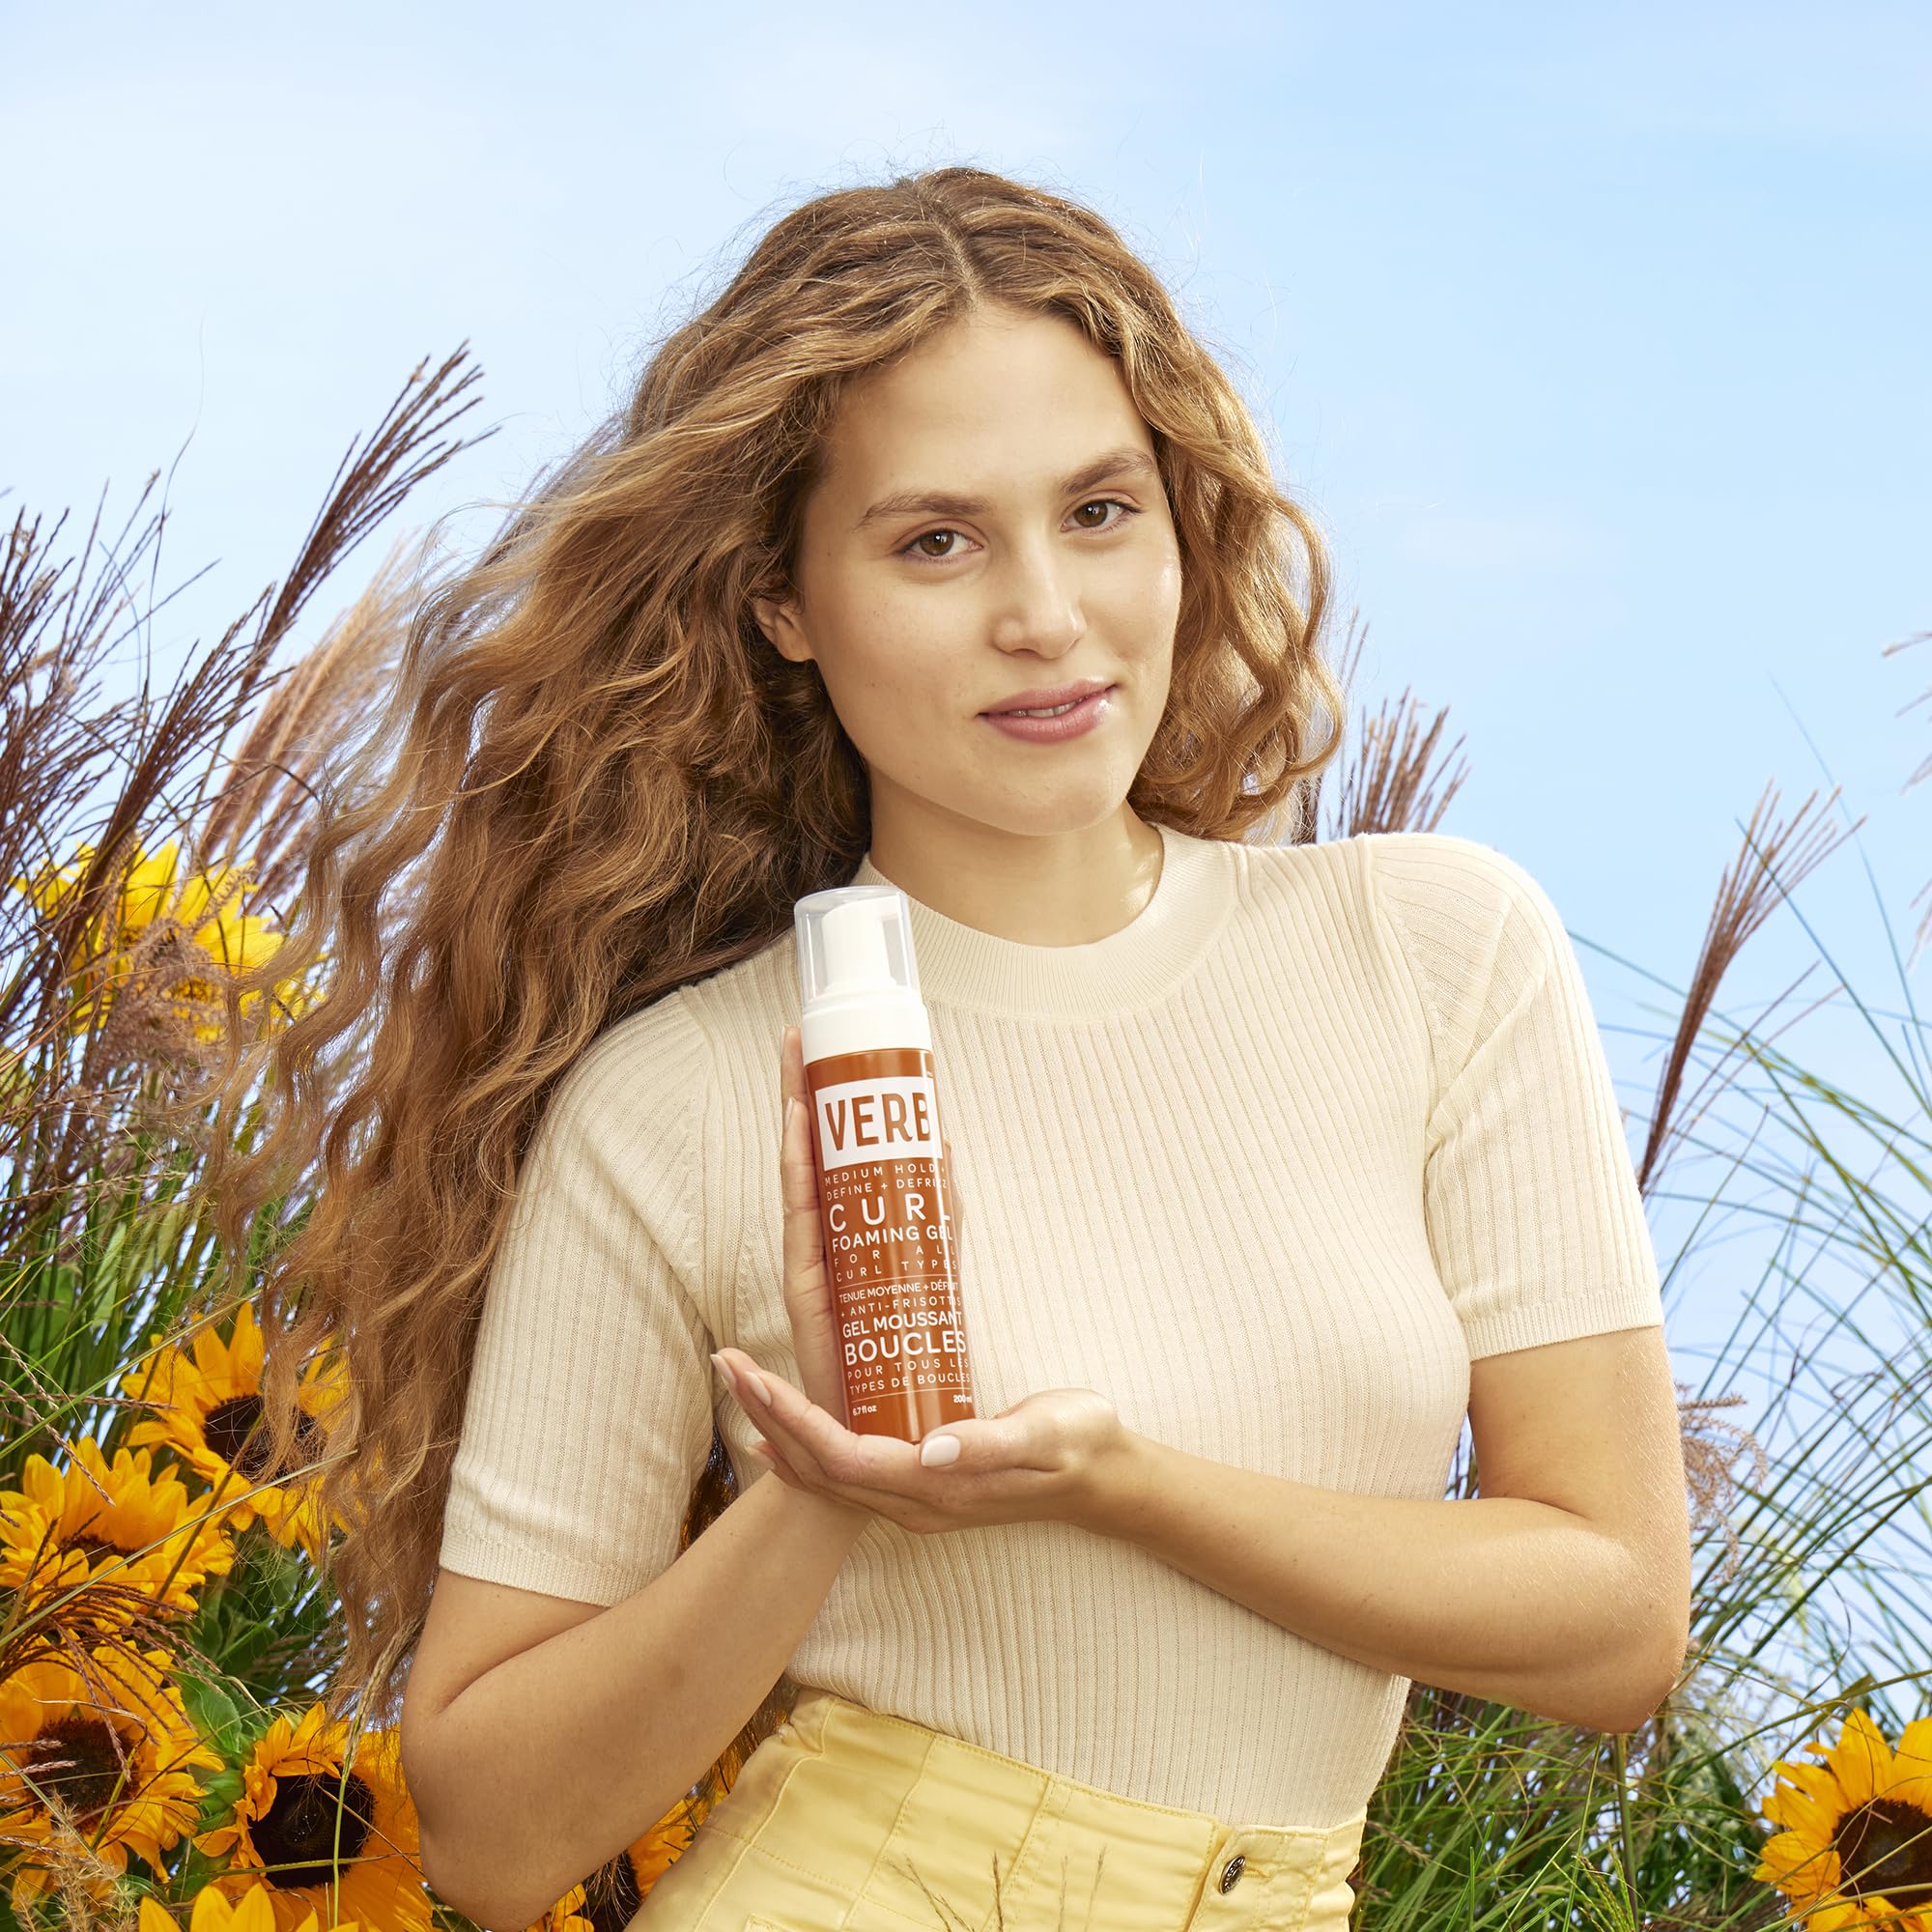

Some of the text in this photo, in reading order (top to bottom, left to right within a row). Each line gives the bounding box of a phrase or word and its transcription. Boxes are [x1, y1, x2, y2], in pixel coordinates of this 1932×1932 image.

[825, 1093, 931, 1151] VERB
[825, 1166, 883, 1186] MEDIUM
[895, 1163, 935, 1174] HOLD
[827, 1182, 872, 1201] DEFINE
[896, 1178, 947, 1189] DEFRIZ
[832, 1225, 953, 1253] FOAMING GEL
[834, 1245, 955, 1267] FOR ALL
[836, 1259, 956, 1282] CURL TYPES
[838, 1289, 866, 1304] TENUE
[867, 1282, 922, 1297] MOYENNE
[842, 1311, 962, 1338] GEL MOUSSANT
[845, 1330, 966, 1366] BOUCLES
[848, 1358, 968, 1380] POUR TOUS LES
[850, 1373, 970, 1396] TYPES DE BOUCLES
